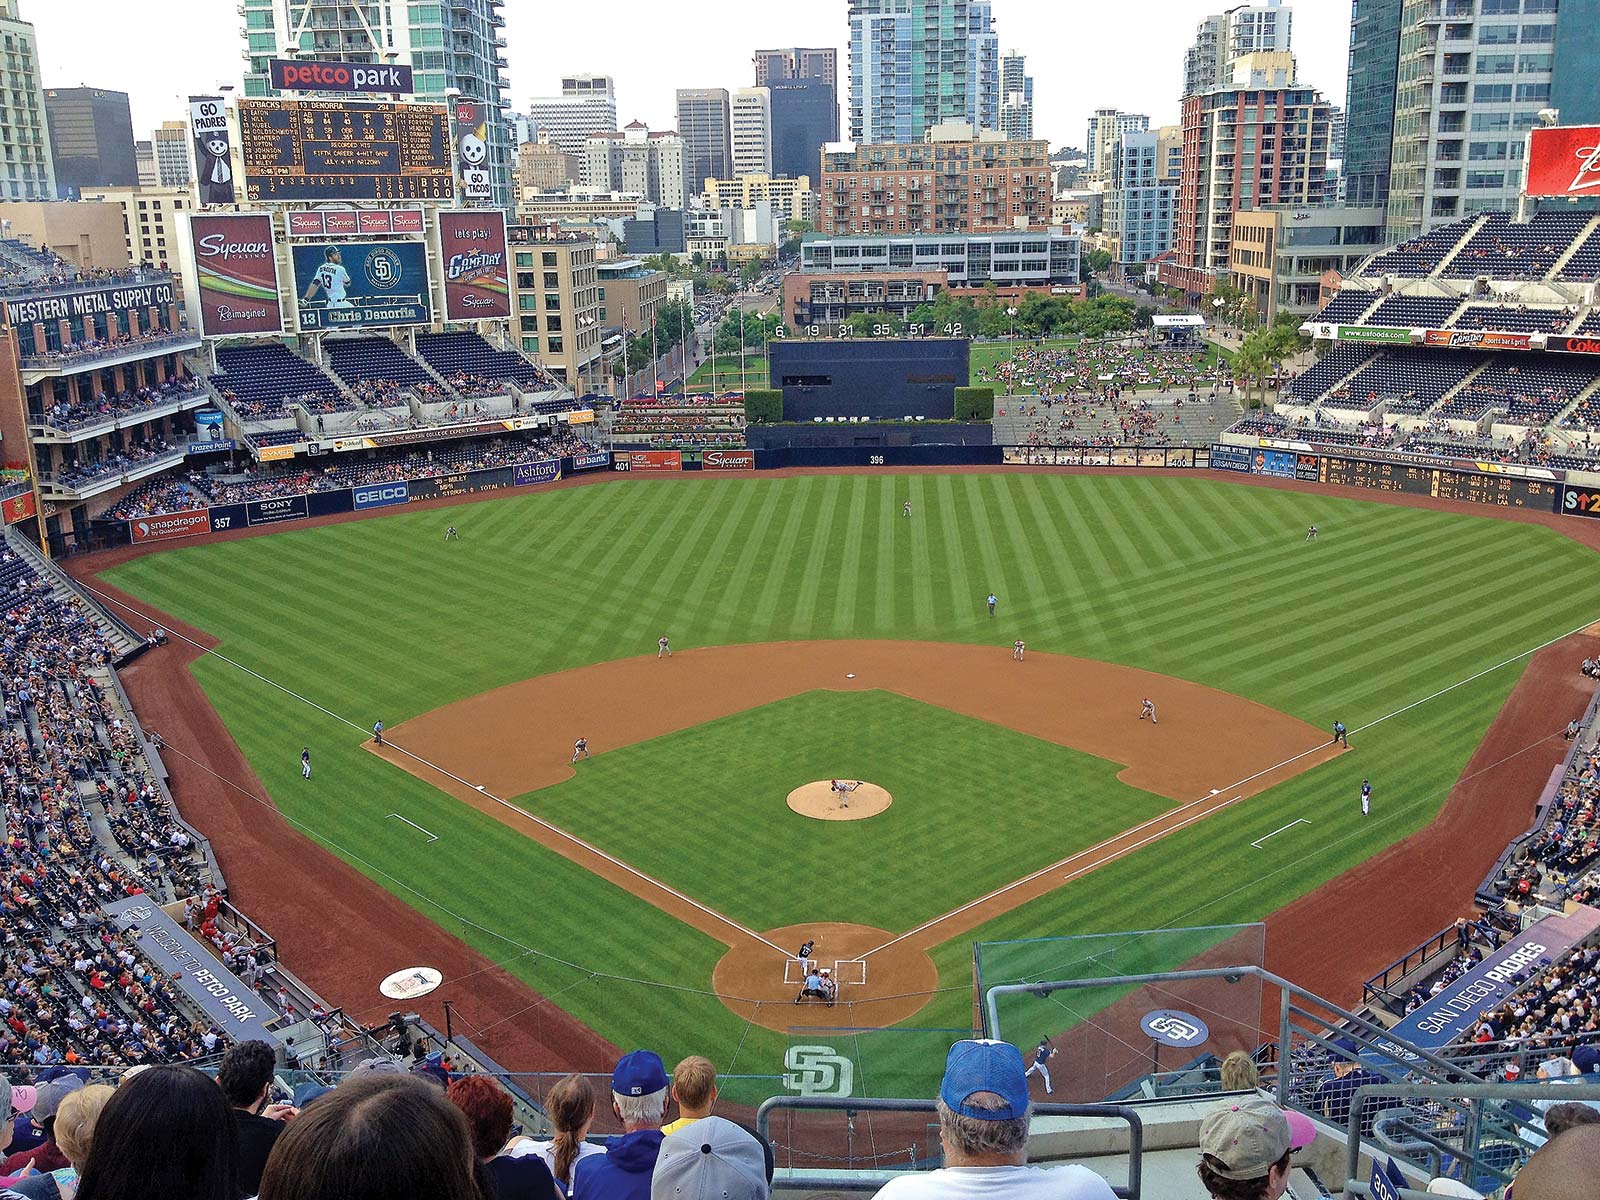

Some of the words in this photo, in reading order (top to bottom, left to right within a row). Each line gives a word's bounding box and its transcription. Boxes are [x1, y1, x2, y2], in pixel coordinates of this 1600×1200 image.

[283, 63, 350, 88] petco
[353, 68, 401, 89] park
[200, 103, 218, 117] GO
[195, 116, 227, 129] PADRES
[270, 177, 274, 185] 1
[280, 177, 285, 185] 2
[421, 178, 428, 187] B
[471, 173, 483, 183] GO
[422, 188, 428, 198] 1
[433, 188, 440, 198] 0
[445, 188, 451, 198] 0
[468, 183, 490, 193] TACOS
[291, 216, 321, 229] Sycuan
[326, 216, 355, 228] Sycuan
[360, 215, 389, 227] Sycuan
[393, 215, 421, 227] Sycuan
[454, 228, 471, 239] let's
[472, 227, 492, 240] play!
[199, 234, 270, 261] Sycuan
[448, 252, 502, 279] GAMEDAY
[320, 273, 333, 290] 13
[7, 297, 70, 324] WESTERN
[73, 294, 112, 316] METAL
[113, 287, 153, 309] SUPPLY
[156, 285, 174, 304] CO.
[462, 294, 495, 309] Sycuan
[217, 305, 267, 321] Reimagined
[302, 313, 316, 325] 13
[328, 309, 362, 322] Chris
[363, 307, 417, 321] Denorfia
[775, 325, 785, 337] 6
[804, 325, 819, 337] 19
[838, 324, 853, 336] 31
[872, 324, 890, 335] 35
[910, 323, 925, 335] 51
[943, 322, 962, 334] 42
[1320, 325, 1331, 334] US
[1344, 329, 1405, 340] www.usfoods.com
[1484, 337, 1501, 345] sports
[191, 443, 214, 452] Frazee
[707, 452, 750, 469] Sycuan
[869, 455, 884, 464] 396
[1172, 459, 1187, 467] 400
[1385, 452, 1413, 462] COLLEGE
[516, 462, 556, 479] Ashford
[615, 461, 629, 471] 401
[355, 486, 408, 504] GEICO
[1565, 491, 1578, 509] S
[260, 499, 293, 511] SONY
[150, 515, 207, 531] snapdragon
[214, 517, 231, 529] 357
[145, 924, 190, 961] WELCOME
[181, 954, 202, 972] TO
[192, 965, 231, 998] PETCO
[220, 992, 257, 1023] PARK
[1417, 1007, 1455, 1035] SAN
[1447, 979, 1498, 1013] DIEGO
[1483, 942, 1548, 983] PADRES
[783, 1045, 853, 1098] SD
